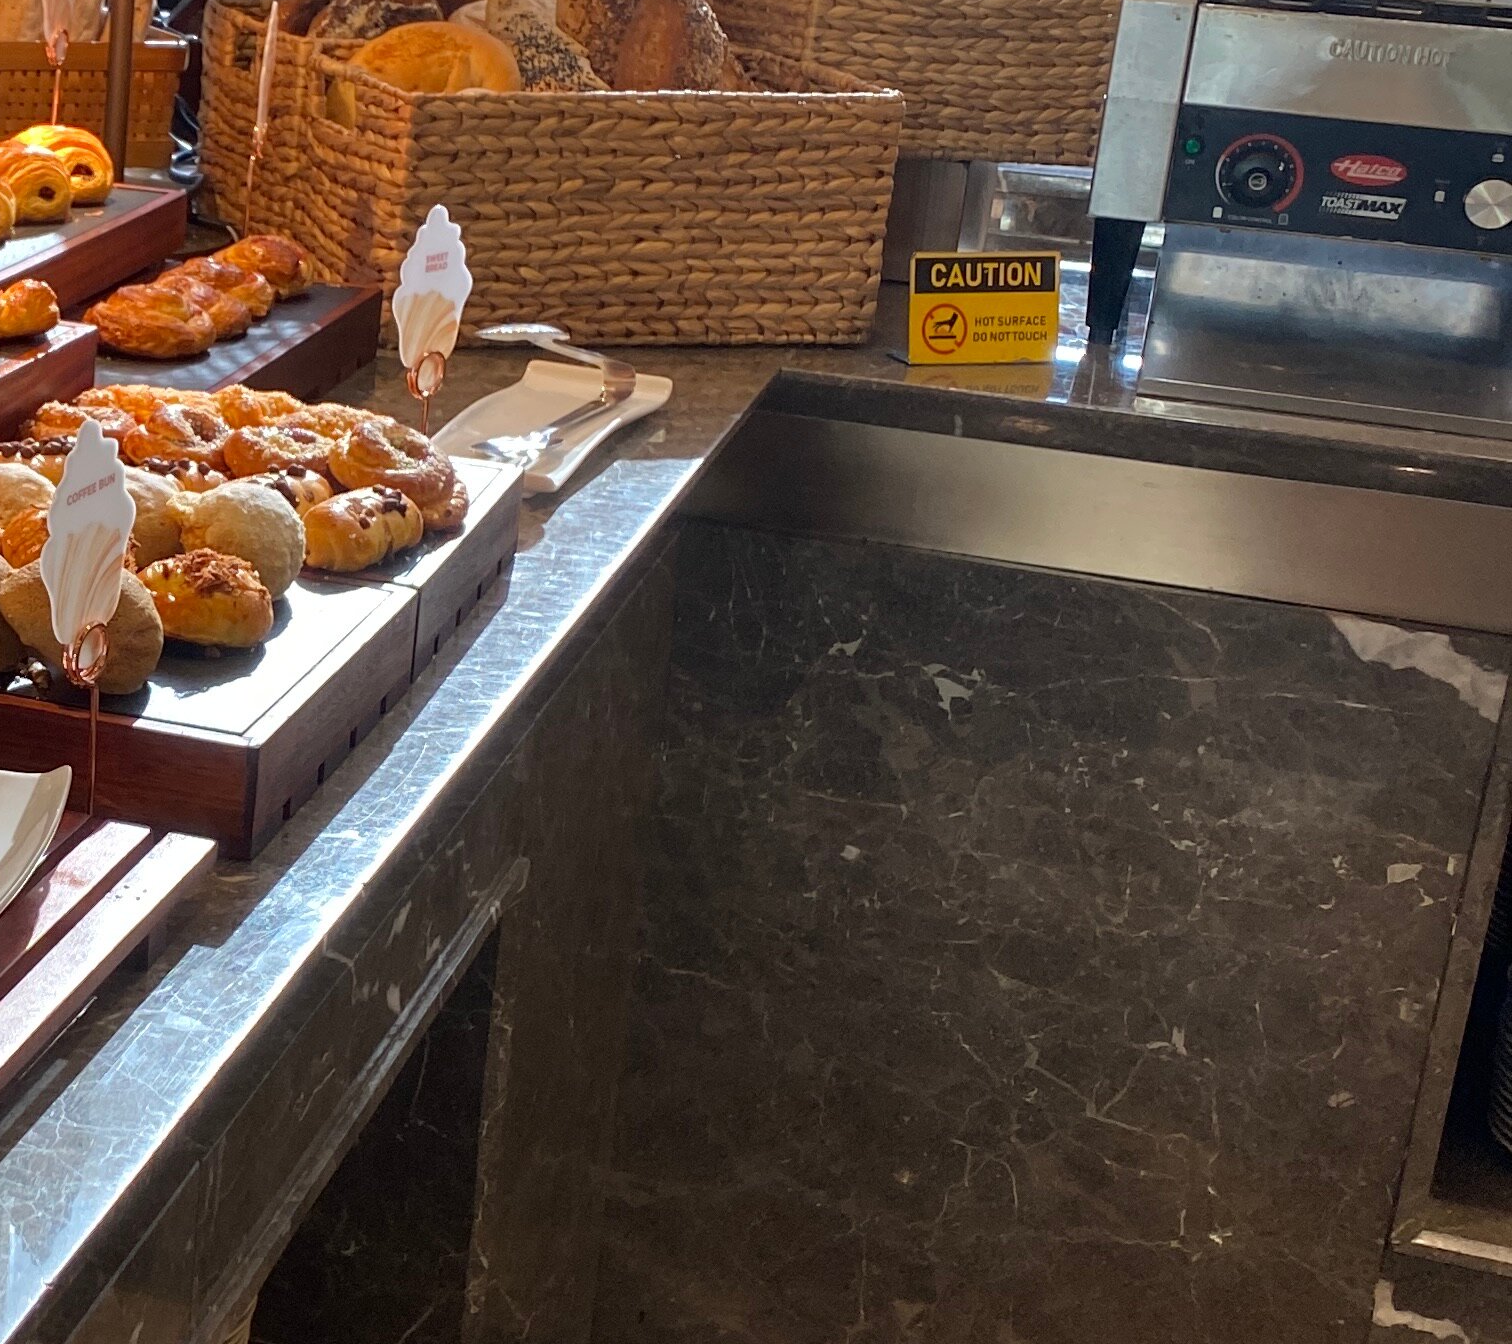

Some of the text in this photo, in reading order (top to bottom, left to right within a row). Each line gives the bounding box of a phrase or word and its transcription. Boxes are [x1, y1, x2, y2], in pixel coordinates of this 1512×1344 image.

[1329, 39, 1452, 67] CAUTION HOT
[930, 261, 1042, 287] CAUTION
[974, 315, 1047, 327] HOT SURFACE
[972, 331, 1048, 342] DO NOT TOUCH
[66, 472, 116, 506] COFFEE BUN
